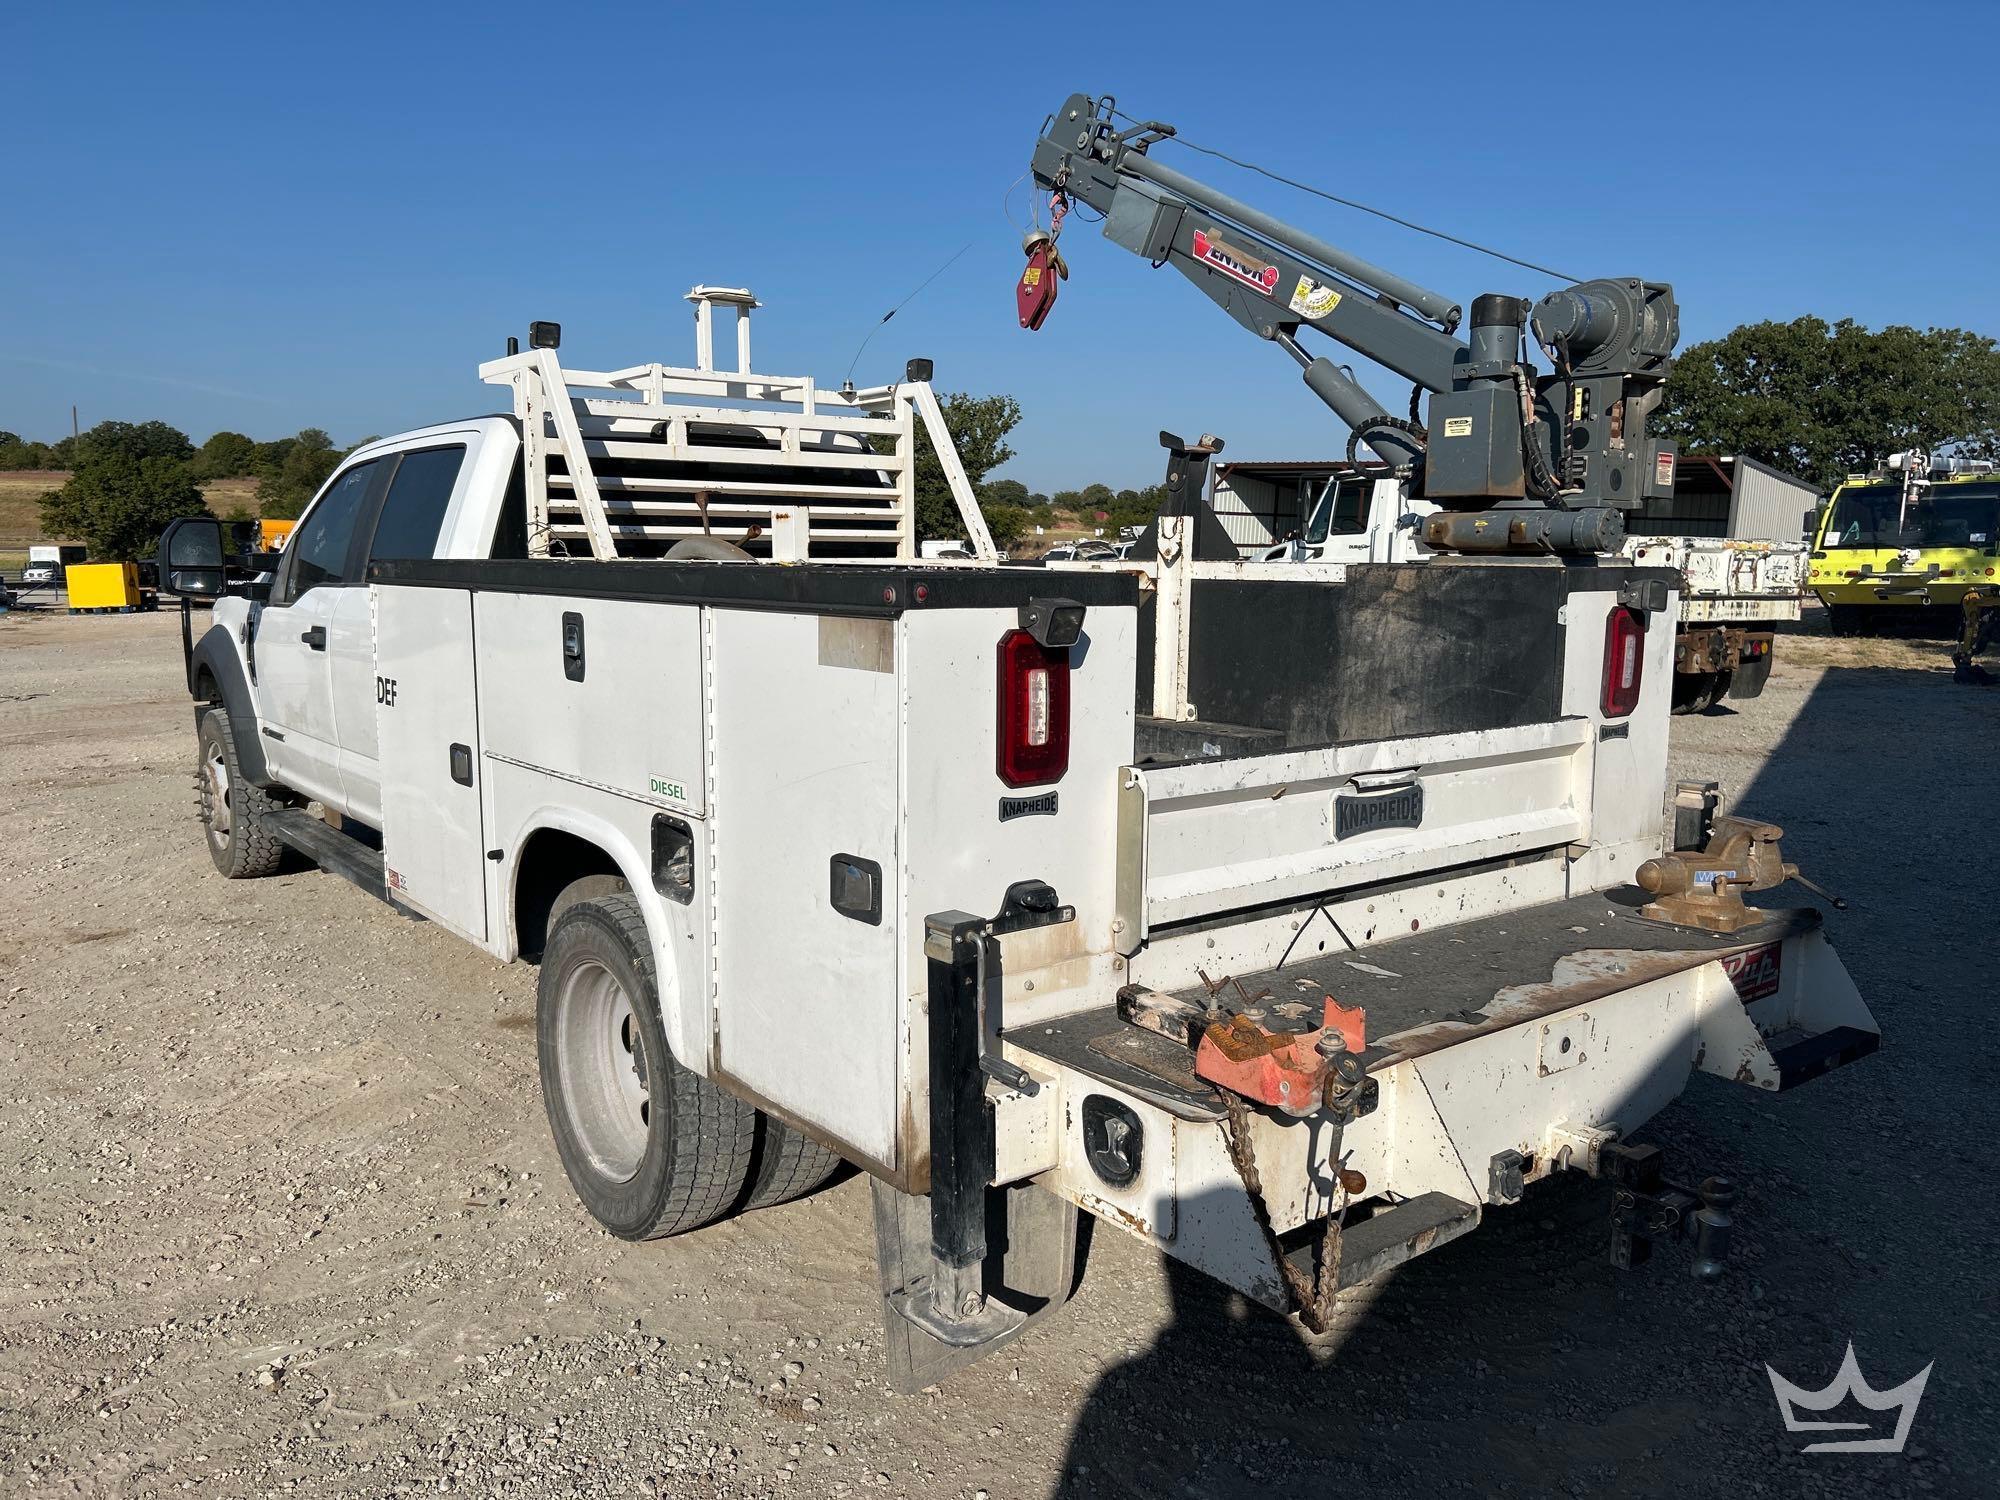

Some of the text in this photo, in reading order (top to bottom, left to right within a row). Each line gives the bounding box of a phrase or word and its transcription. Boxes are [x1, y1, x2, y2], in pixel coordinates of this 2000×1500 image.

[376, 675, 398, 708] DEF
[650, 778, 687, 801] DIESEL
[1002, 795, 1057, 819] KNAPHEIDE
[1339, 792, 1420, 834] KNAPHEIDE
